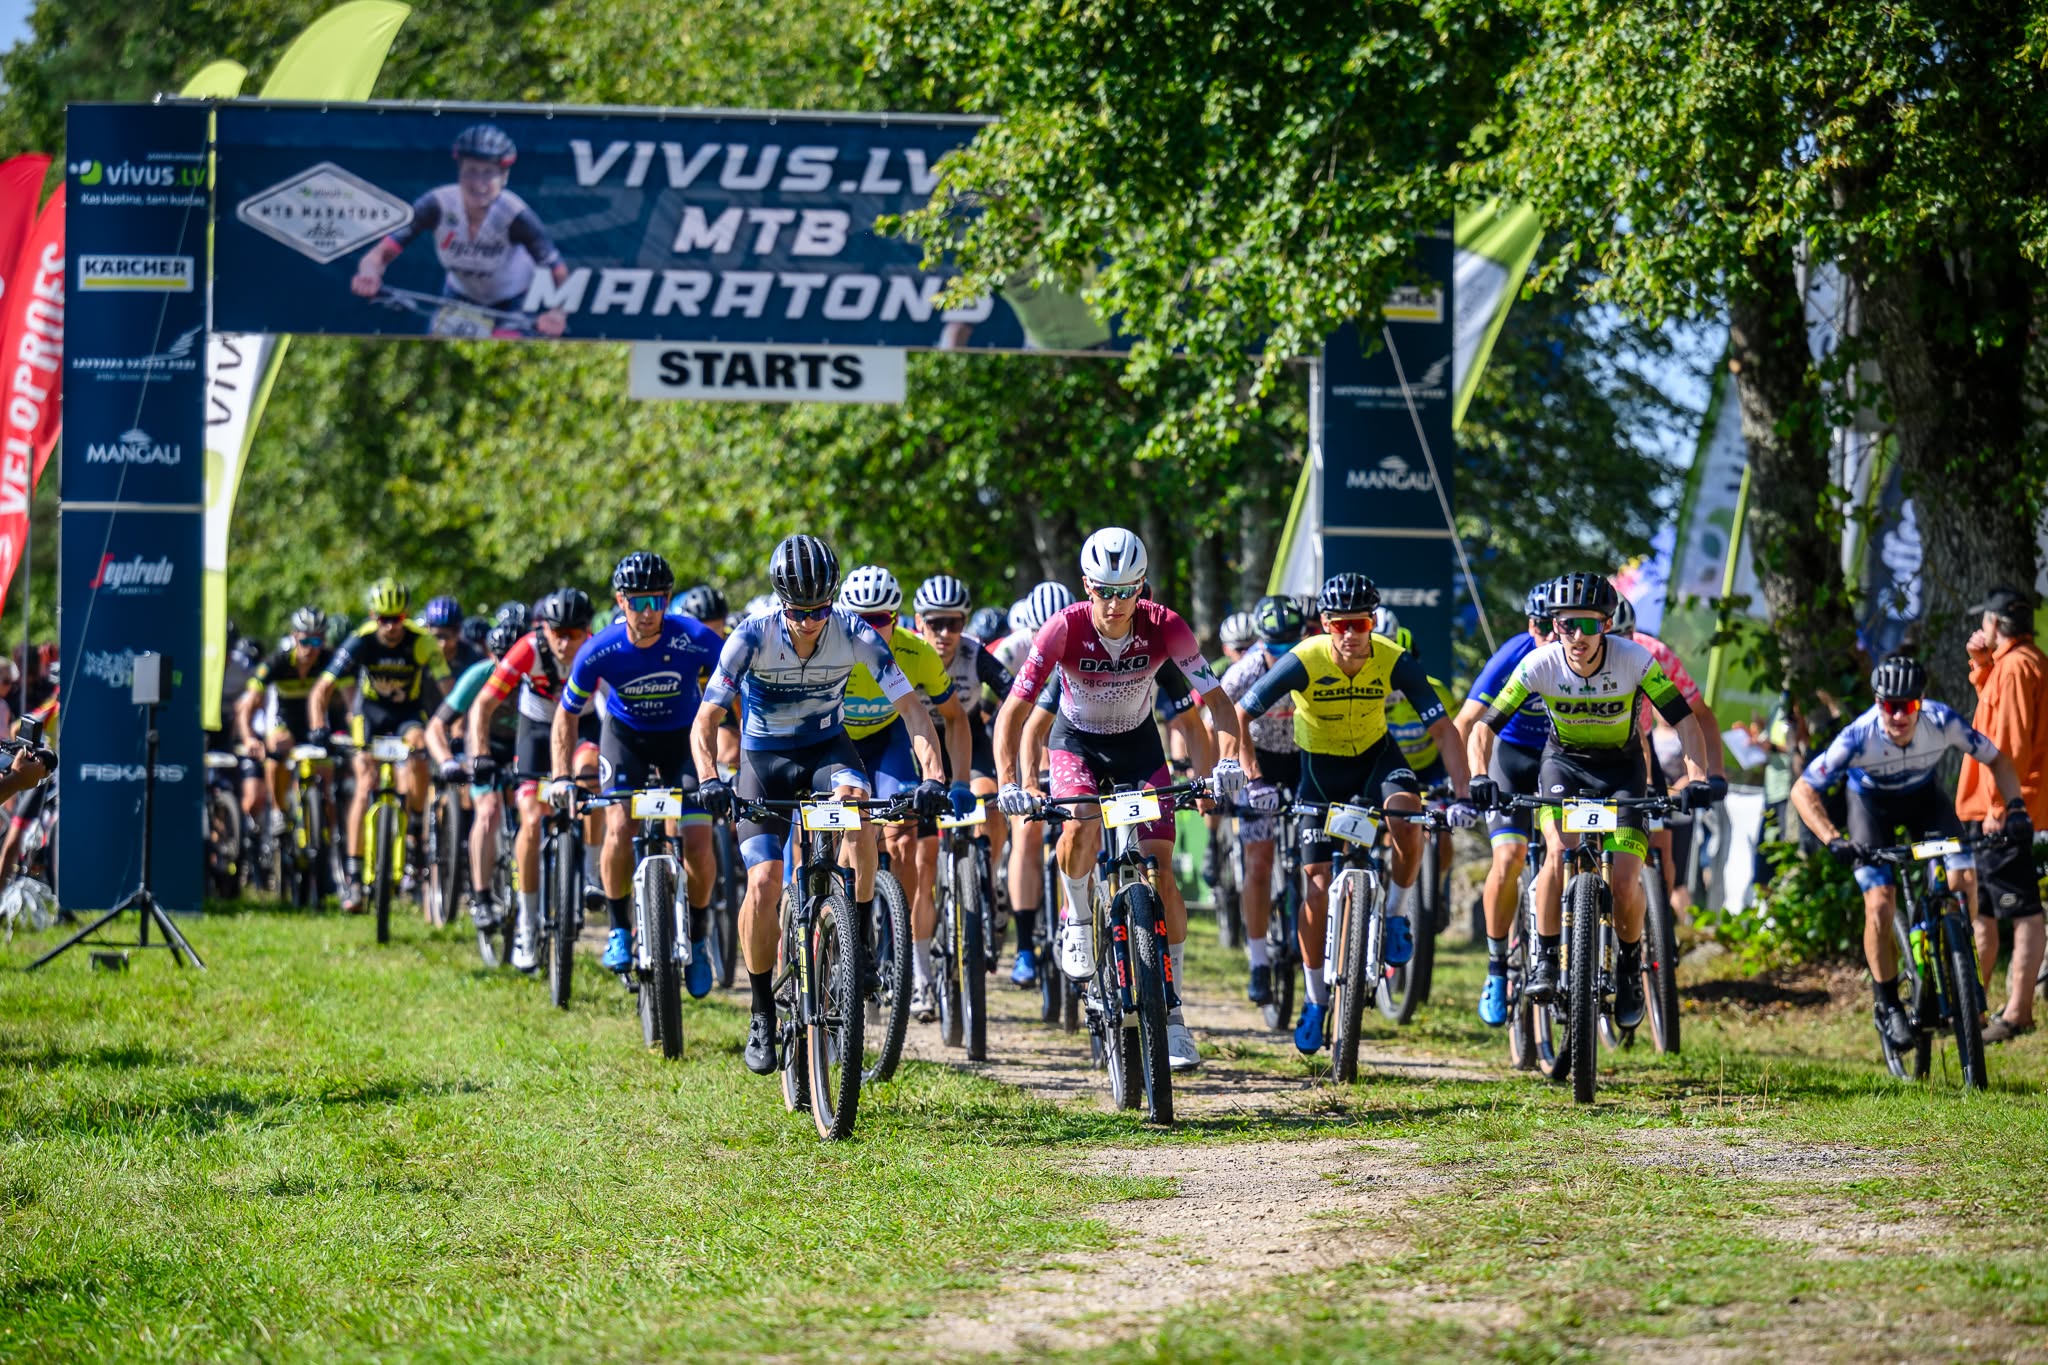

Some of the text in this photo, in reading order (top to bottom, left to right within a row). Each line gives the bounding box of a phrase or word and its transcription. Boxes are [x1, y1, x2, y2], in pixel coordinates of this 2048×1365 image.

[569, 138, 950, 196] VIVUS.LV
[262, 206, 295, 219] MTB
[673, 207, 851, 257] MTB
[659, 350, 864, 391] STARTS
[1079, 655, 1150, 673] DAKO
[1096, 676, 1146, 688] Corporation
[1555, 701, 1625, 715] DAKO
[655, 801, 665, 812] 4
[1129, 804, 1140, 817] 3
[829, 812, 840, 824] 5
[1587, 813, 1599, 825] 8
[1351, 821, 1358, 833] 1
